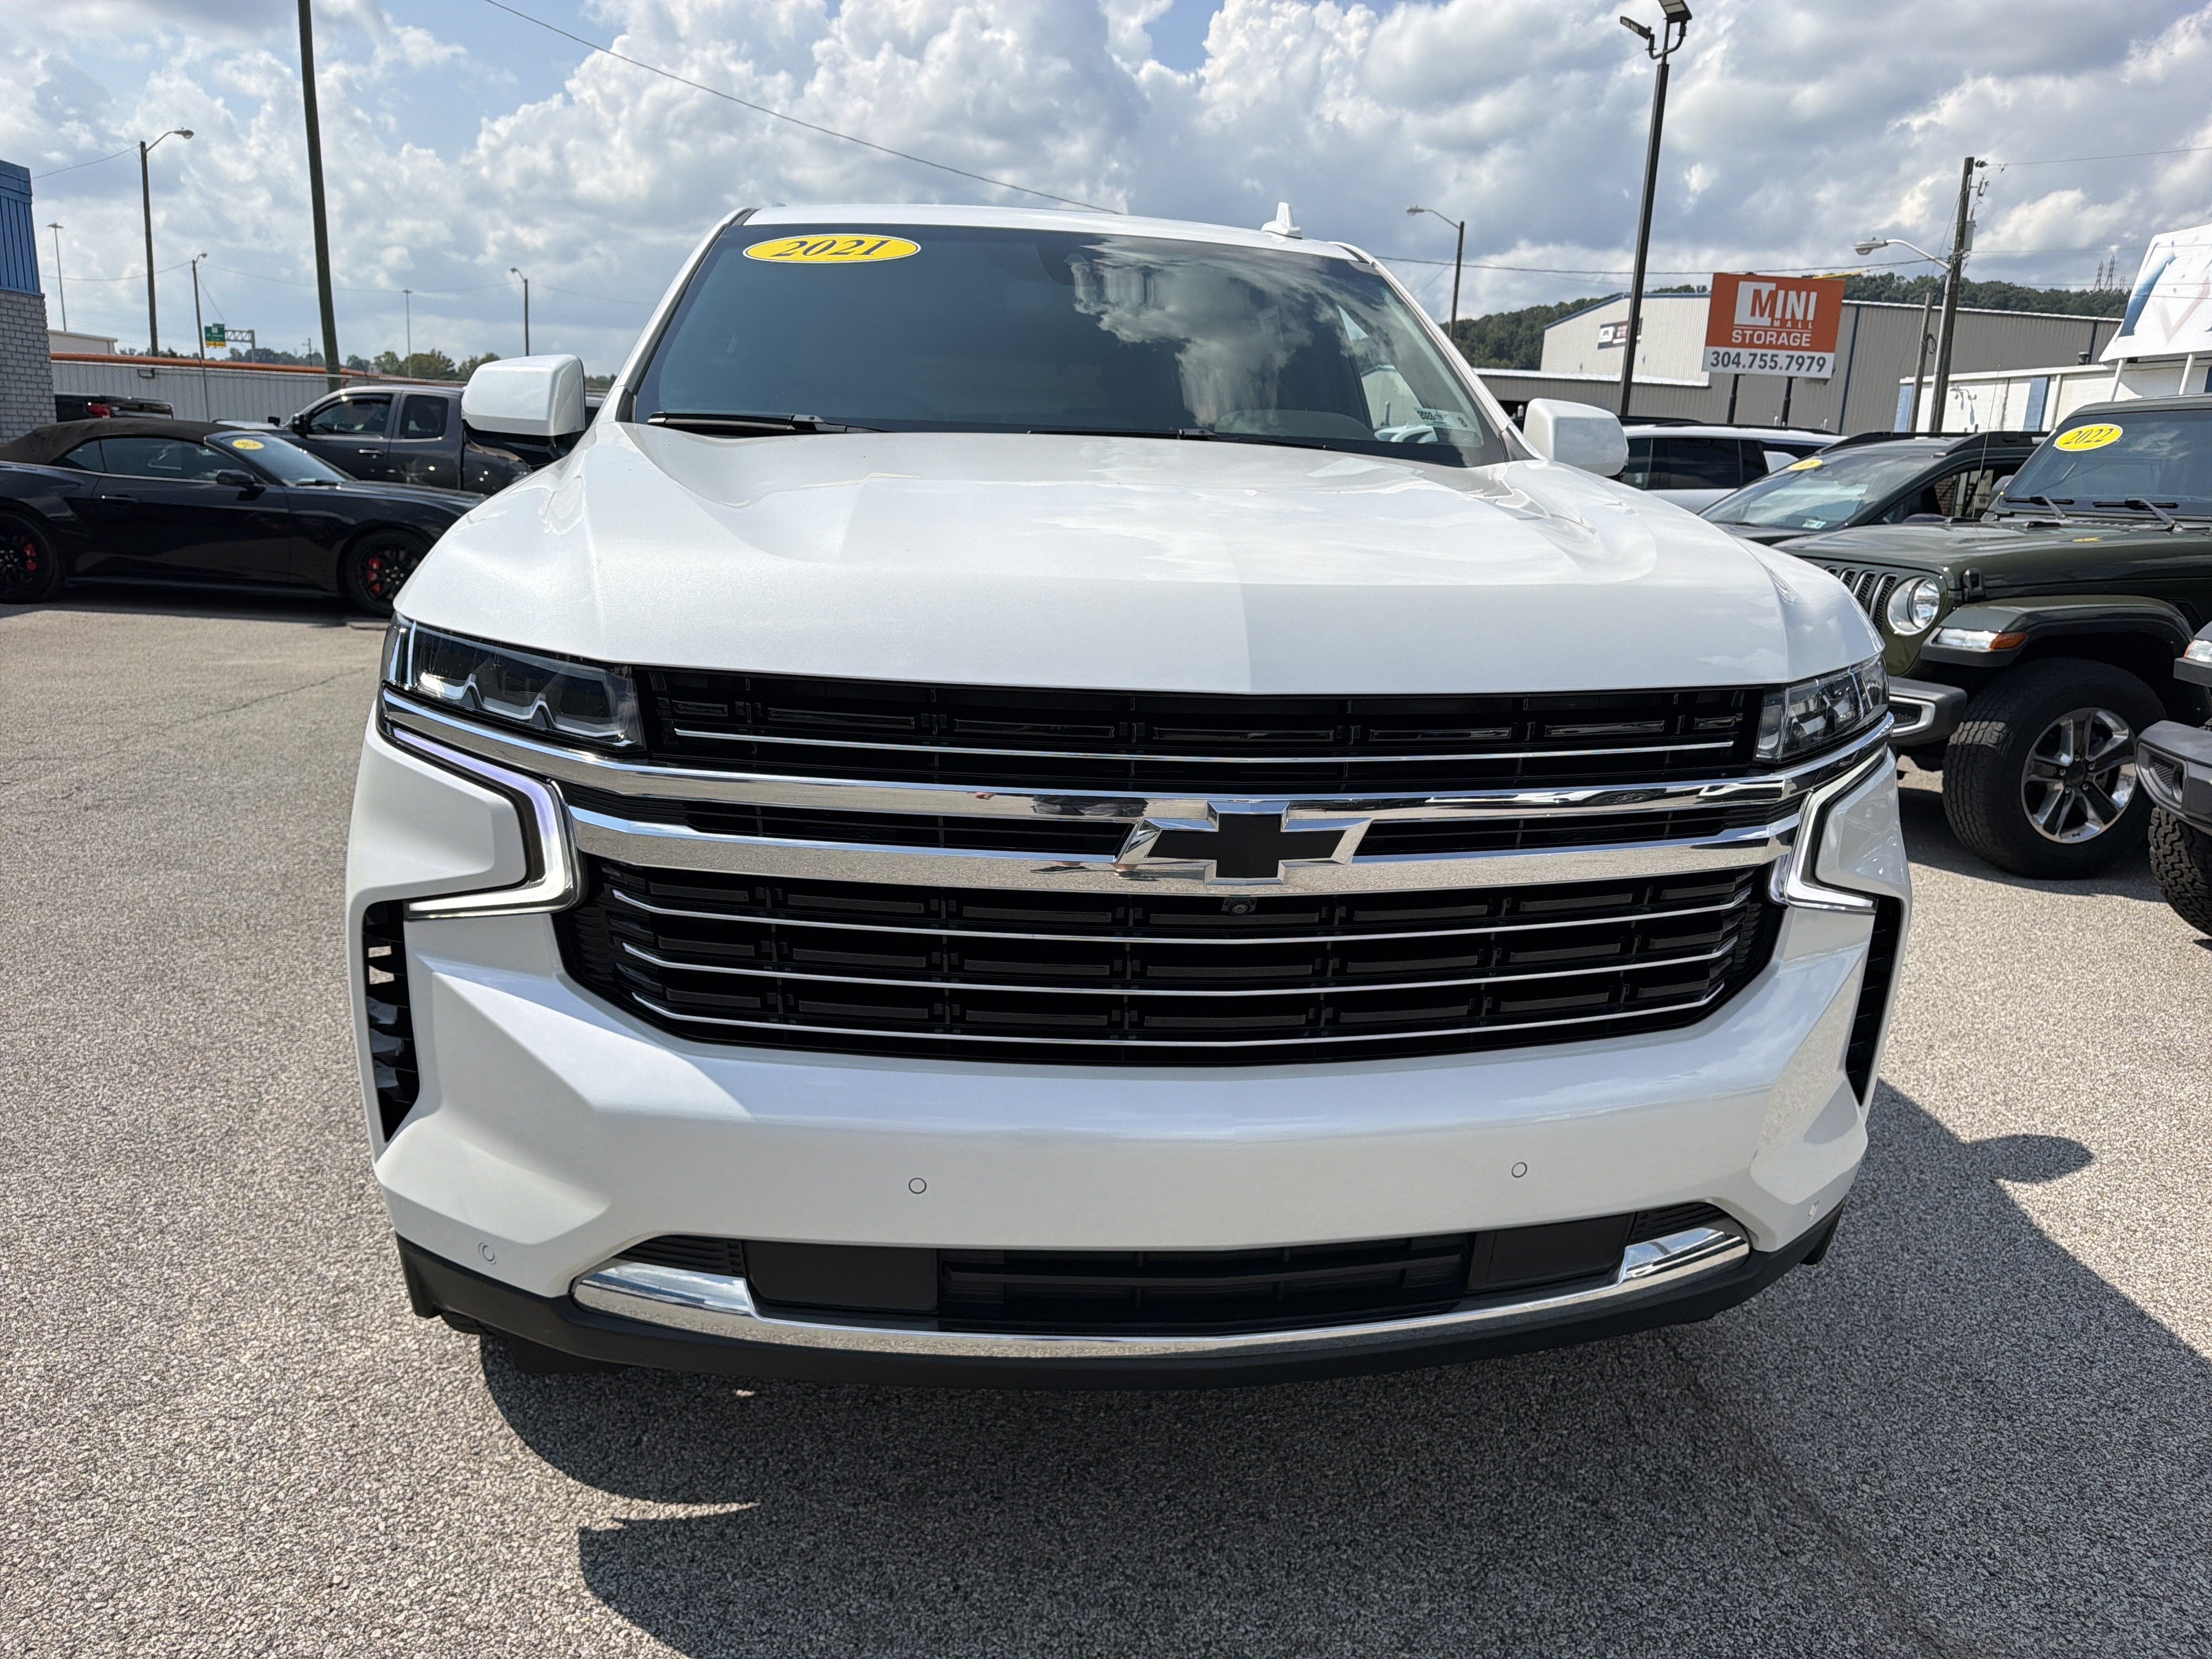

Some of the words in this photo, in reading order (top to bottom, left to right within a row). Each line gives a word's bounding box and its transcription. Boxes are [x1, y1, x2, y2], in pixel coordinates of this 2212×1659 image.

[769, 239, 891, 257] 2021
[1738, 282, 1817, 324] MINI
[1732, 329, 1812, 347] STORAGE
[1710, 351, 1826, 373] 304.755.7979
[2063, 428, 2114, 445] 2022
